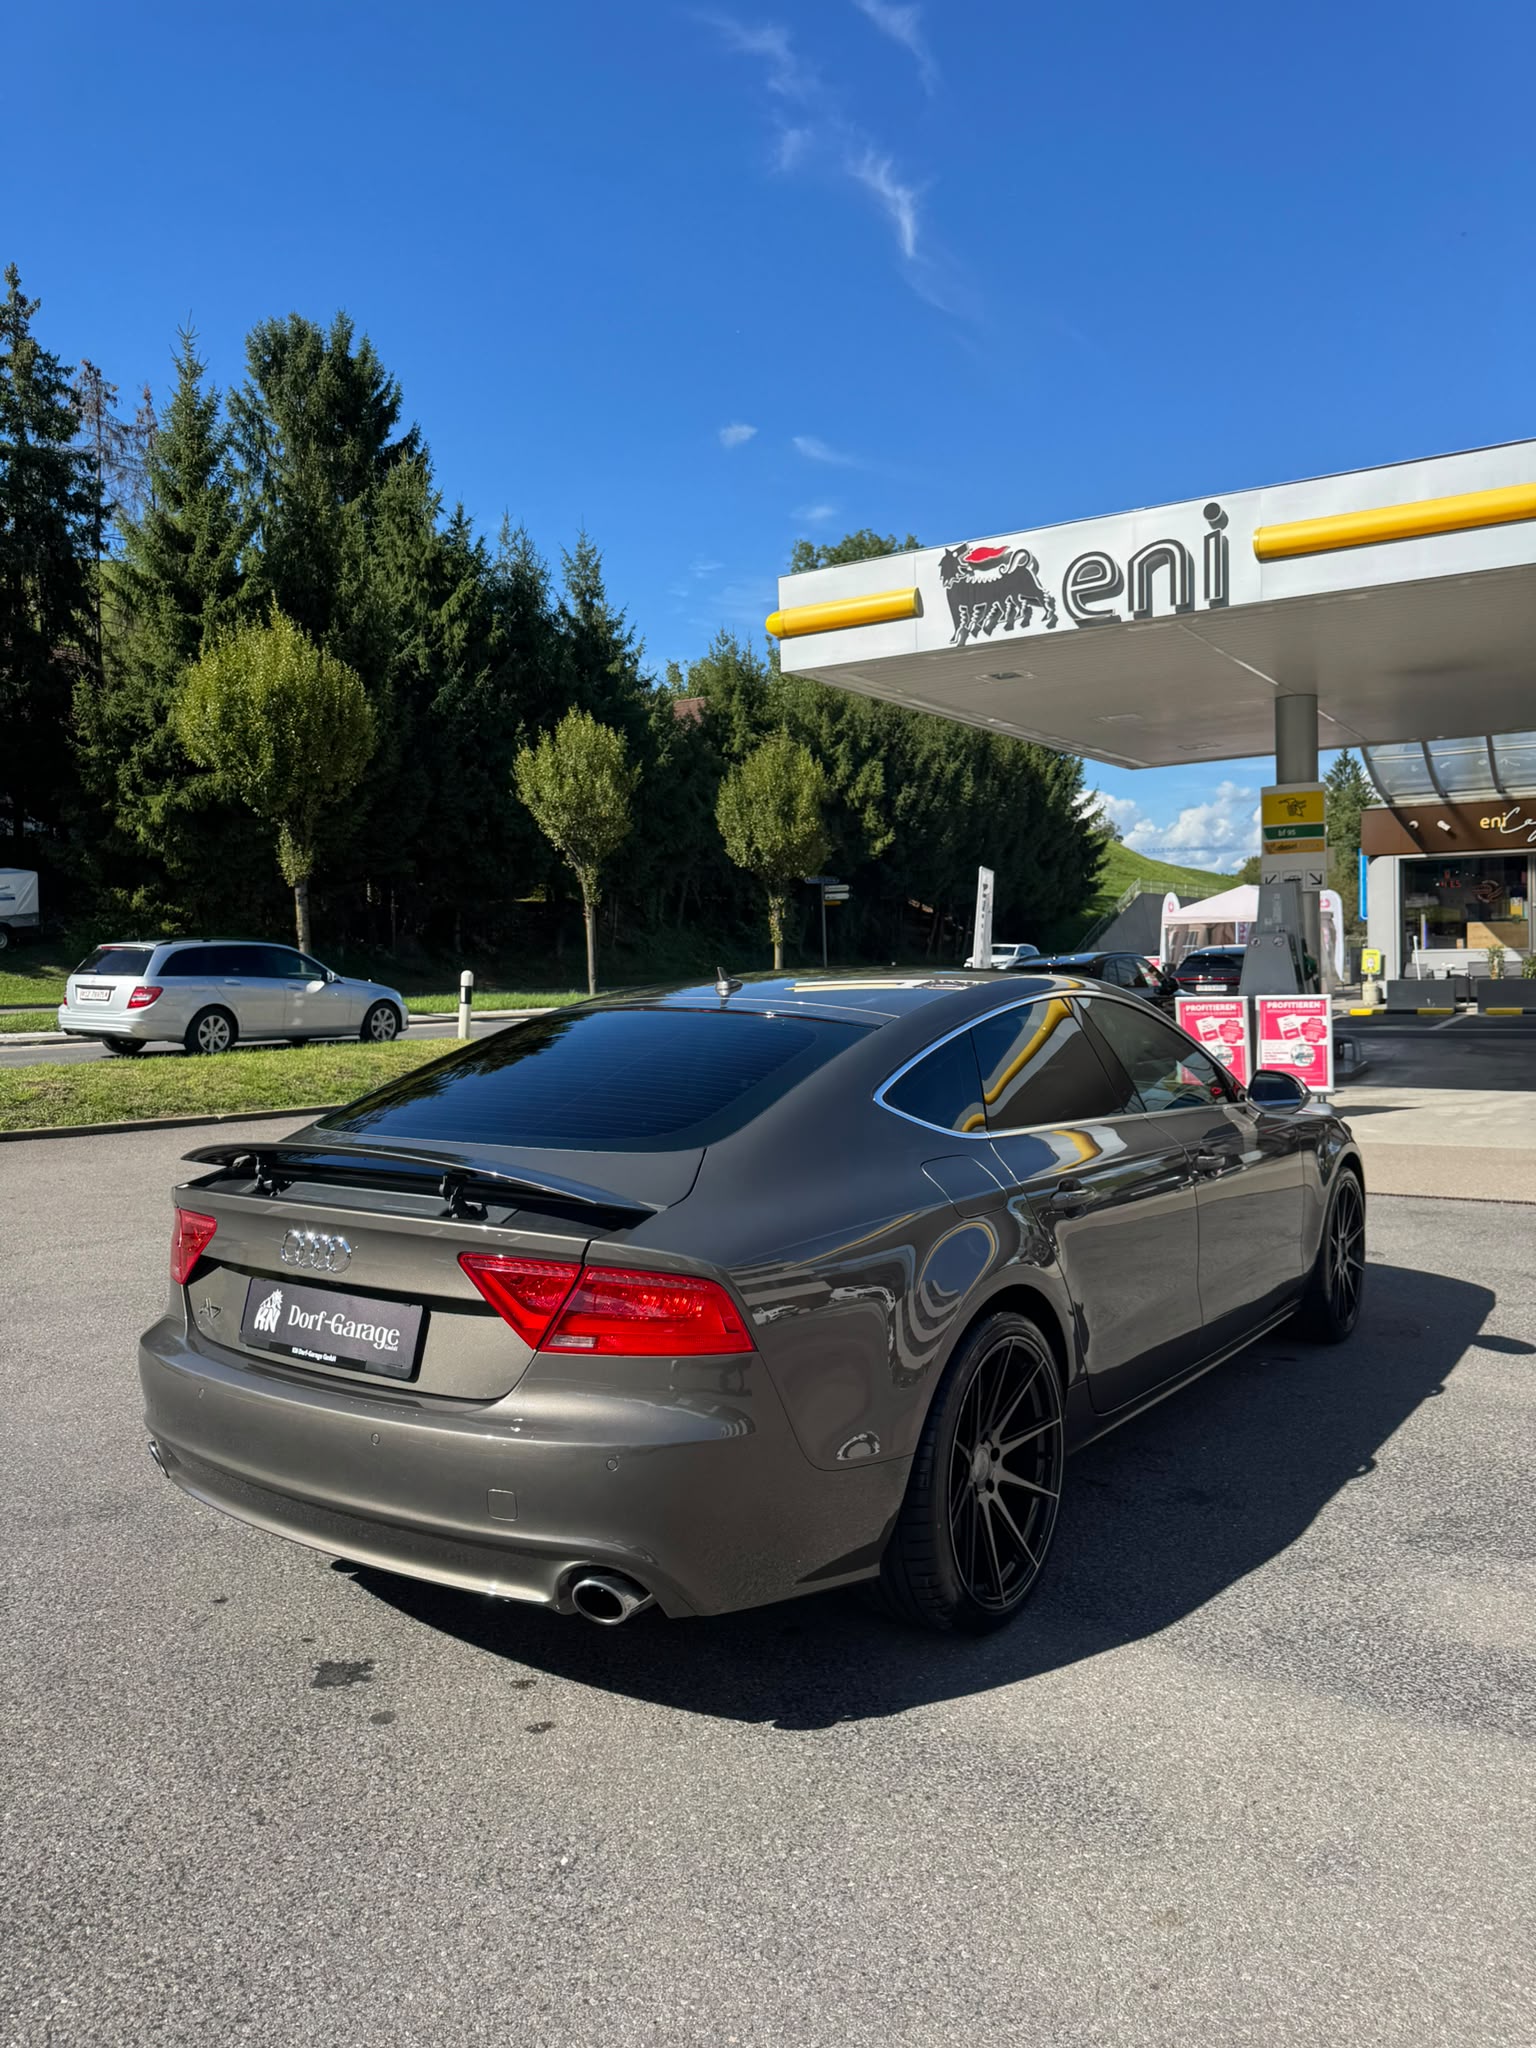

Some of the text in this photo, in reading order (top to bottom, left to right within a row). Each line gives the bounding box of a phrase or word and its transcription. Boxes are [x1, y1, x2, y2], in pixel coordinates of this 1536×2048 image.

[1062, 502, 1228, 621] eni
[1480, 812, 1507, 829] eni
[1185, 1003, 1237, 1012] PROFITIEREN
[1267, 1001, 1321, 1009] PROFITIEREN
[288, 1305, 400, 1350] Dorf-Garage
